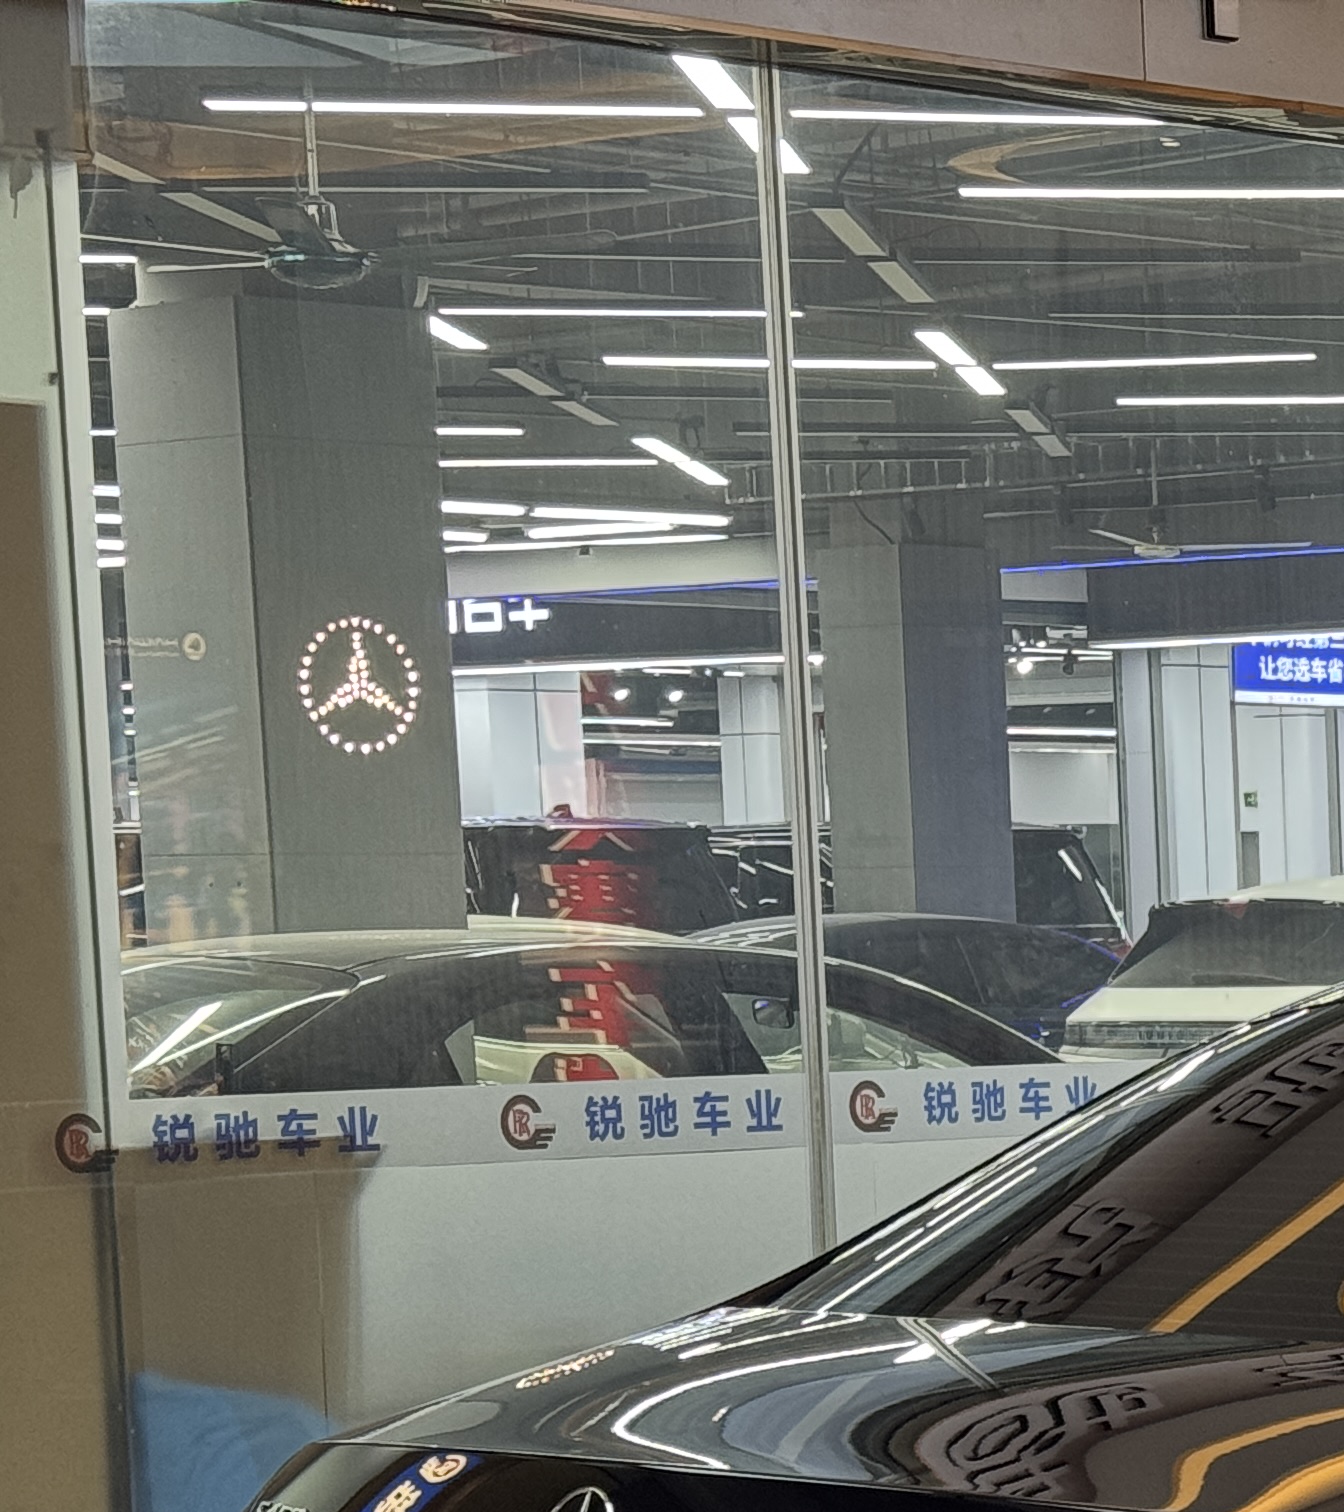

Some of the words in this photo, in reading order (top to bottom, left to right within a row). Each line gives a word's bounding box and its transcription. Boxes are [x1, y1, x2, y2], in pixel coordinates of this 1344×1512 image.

[585, 1088, 783, 1143] 锐驰车业
[923, 1074, 1098, 1127] 锐驰车业
[153, 1105, 381, 1164] 锐驰车业
